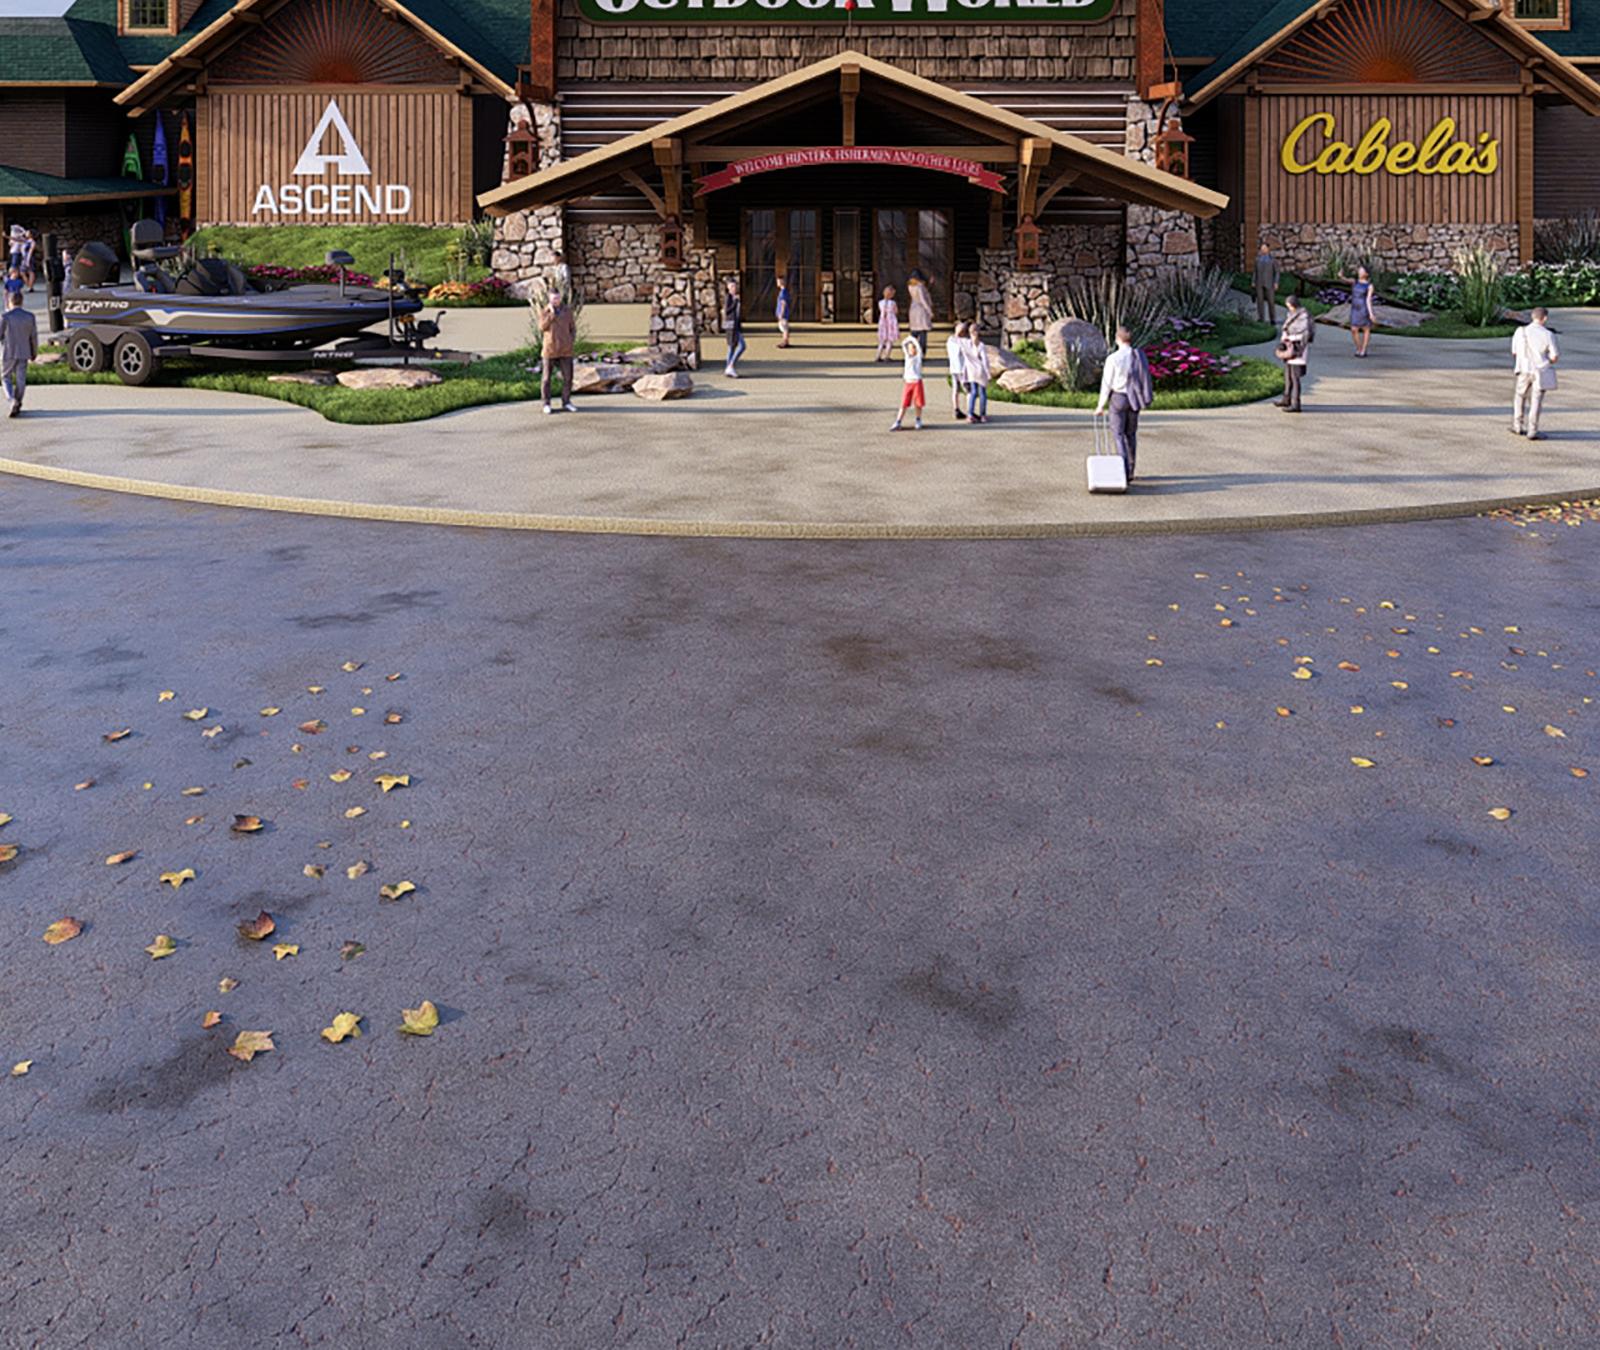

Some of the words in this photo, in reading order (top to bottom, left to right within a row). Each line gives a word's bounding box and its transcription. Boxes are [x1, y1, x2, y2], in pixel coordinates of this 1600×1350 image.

[1281, 112, 1499, 174] Cabela's
[734, 155, 783, 174] WELCOME
[835, 149, 892, 161] FISHERMEN
[893, 151, 915, 163] AND
[916, 153, 951, 167] OTHER
[252, 183, 412, 215] ASCEND
